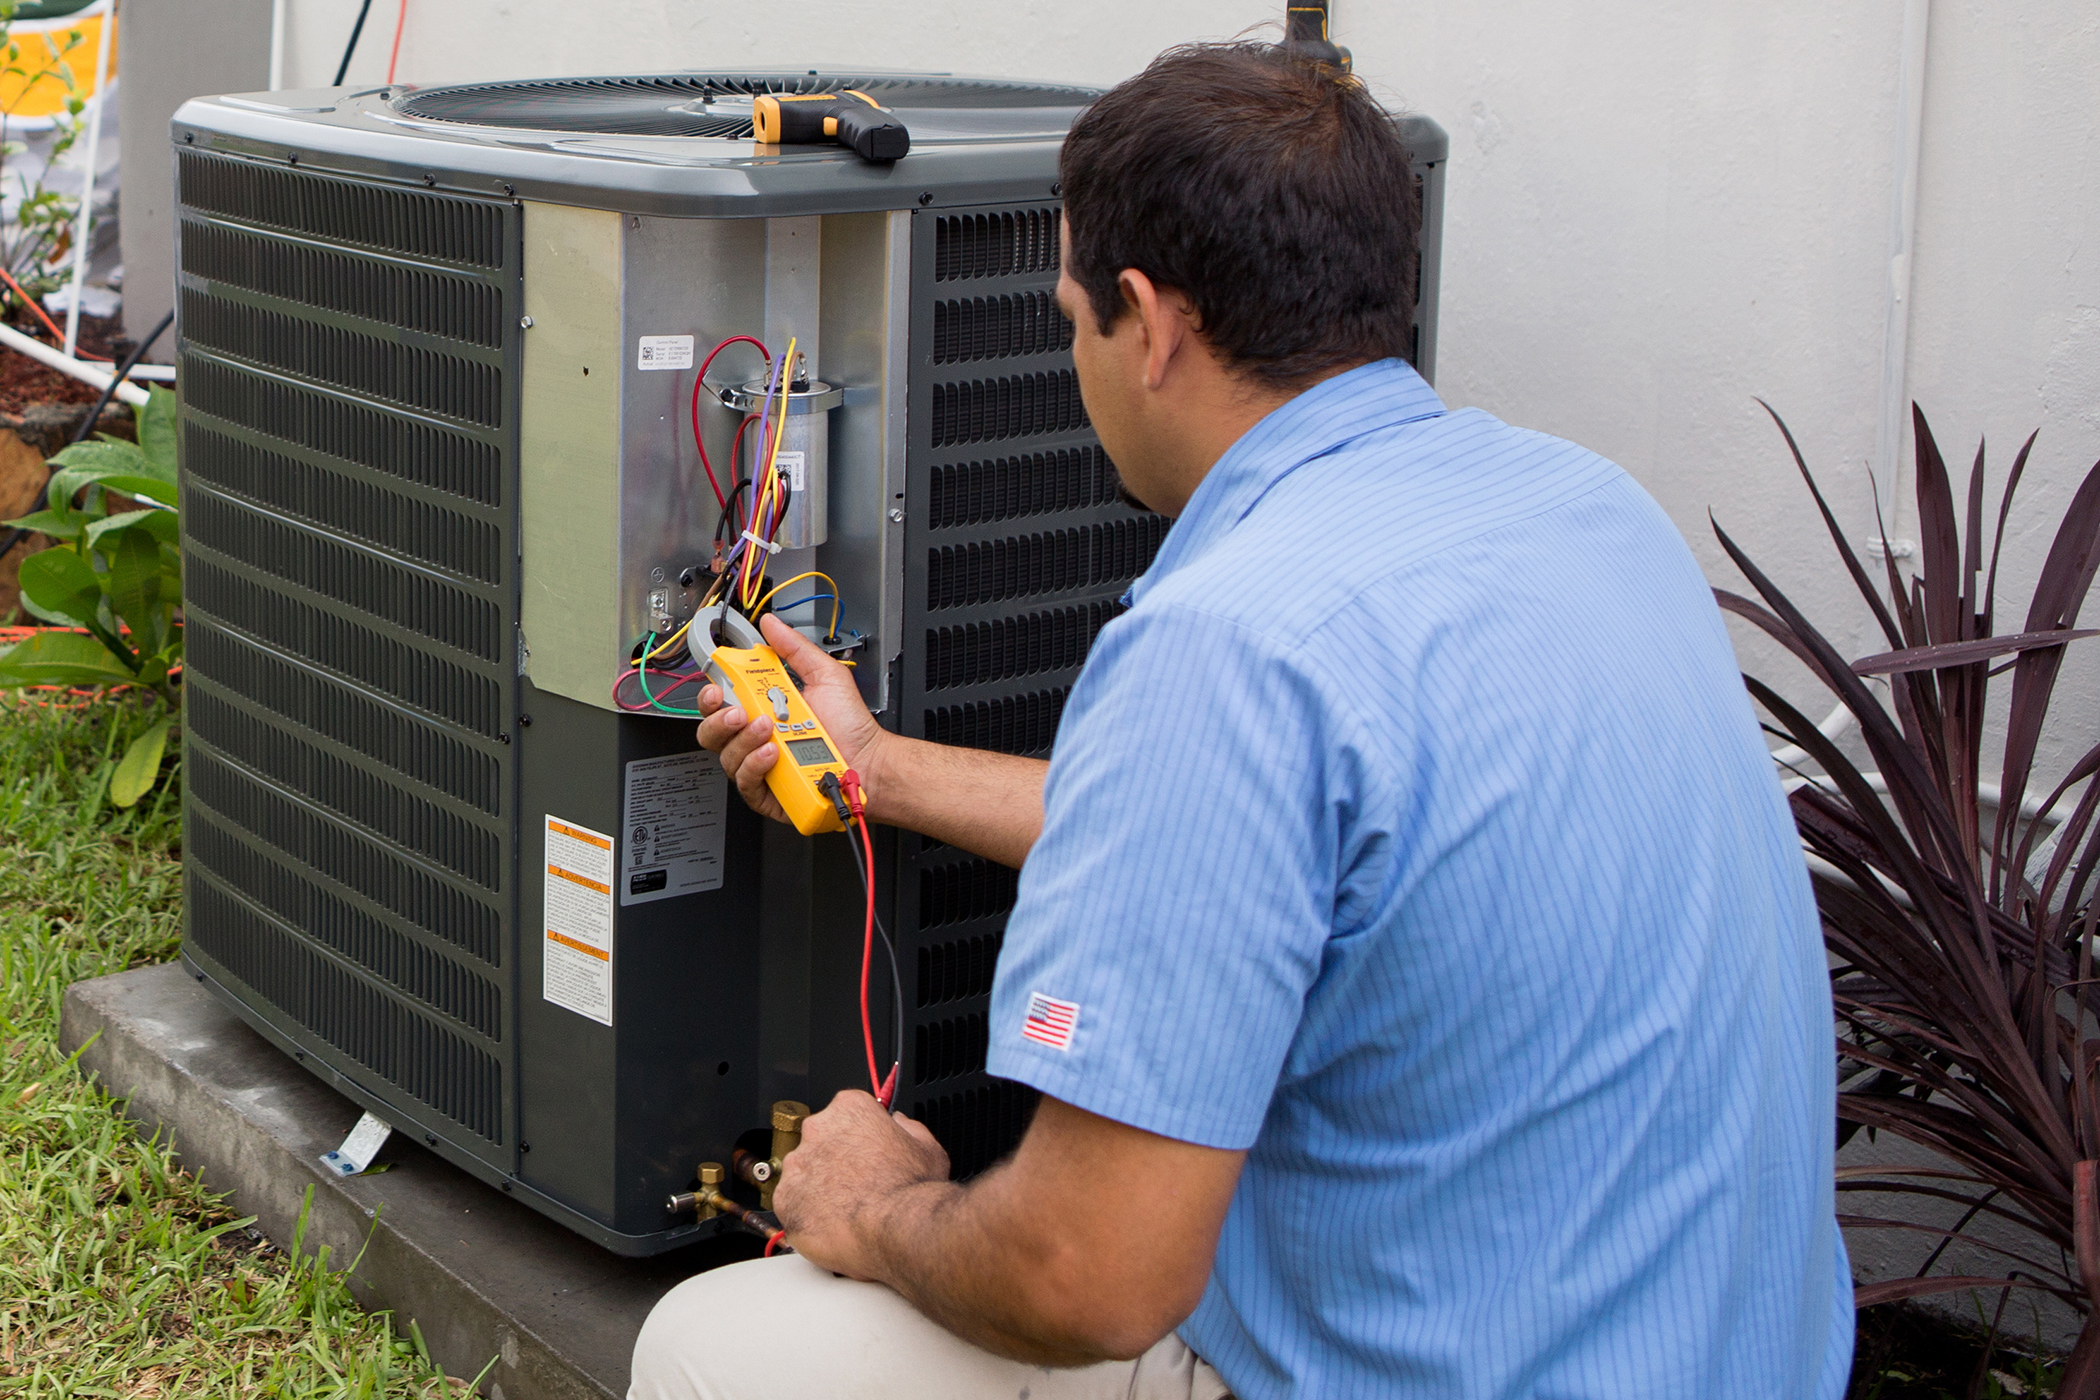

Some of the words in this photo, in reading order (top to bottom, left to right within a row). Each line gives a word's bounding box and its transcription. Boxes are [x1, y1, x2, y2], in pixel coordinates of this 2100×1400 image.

[571, 830, 597, 844] WARNING
[565, 873, 602, 890] ADVERTENCIA
[560, 938, 604, 957] AVERTISSEMENT
